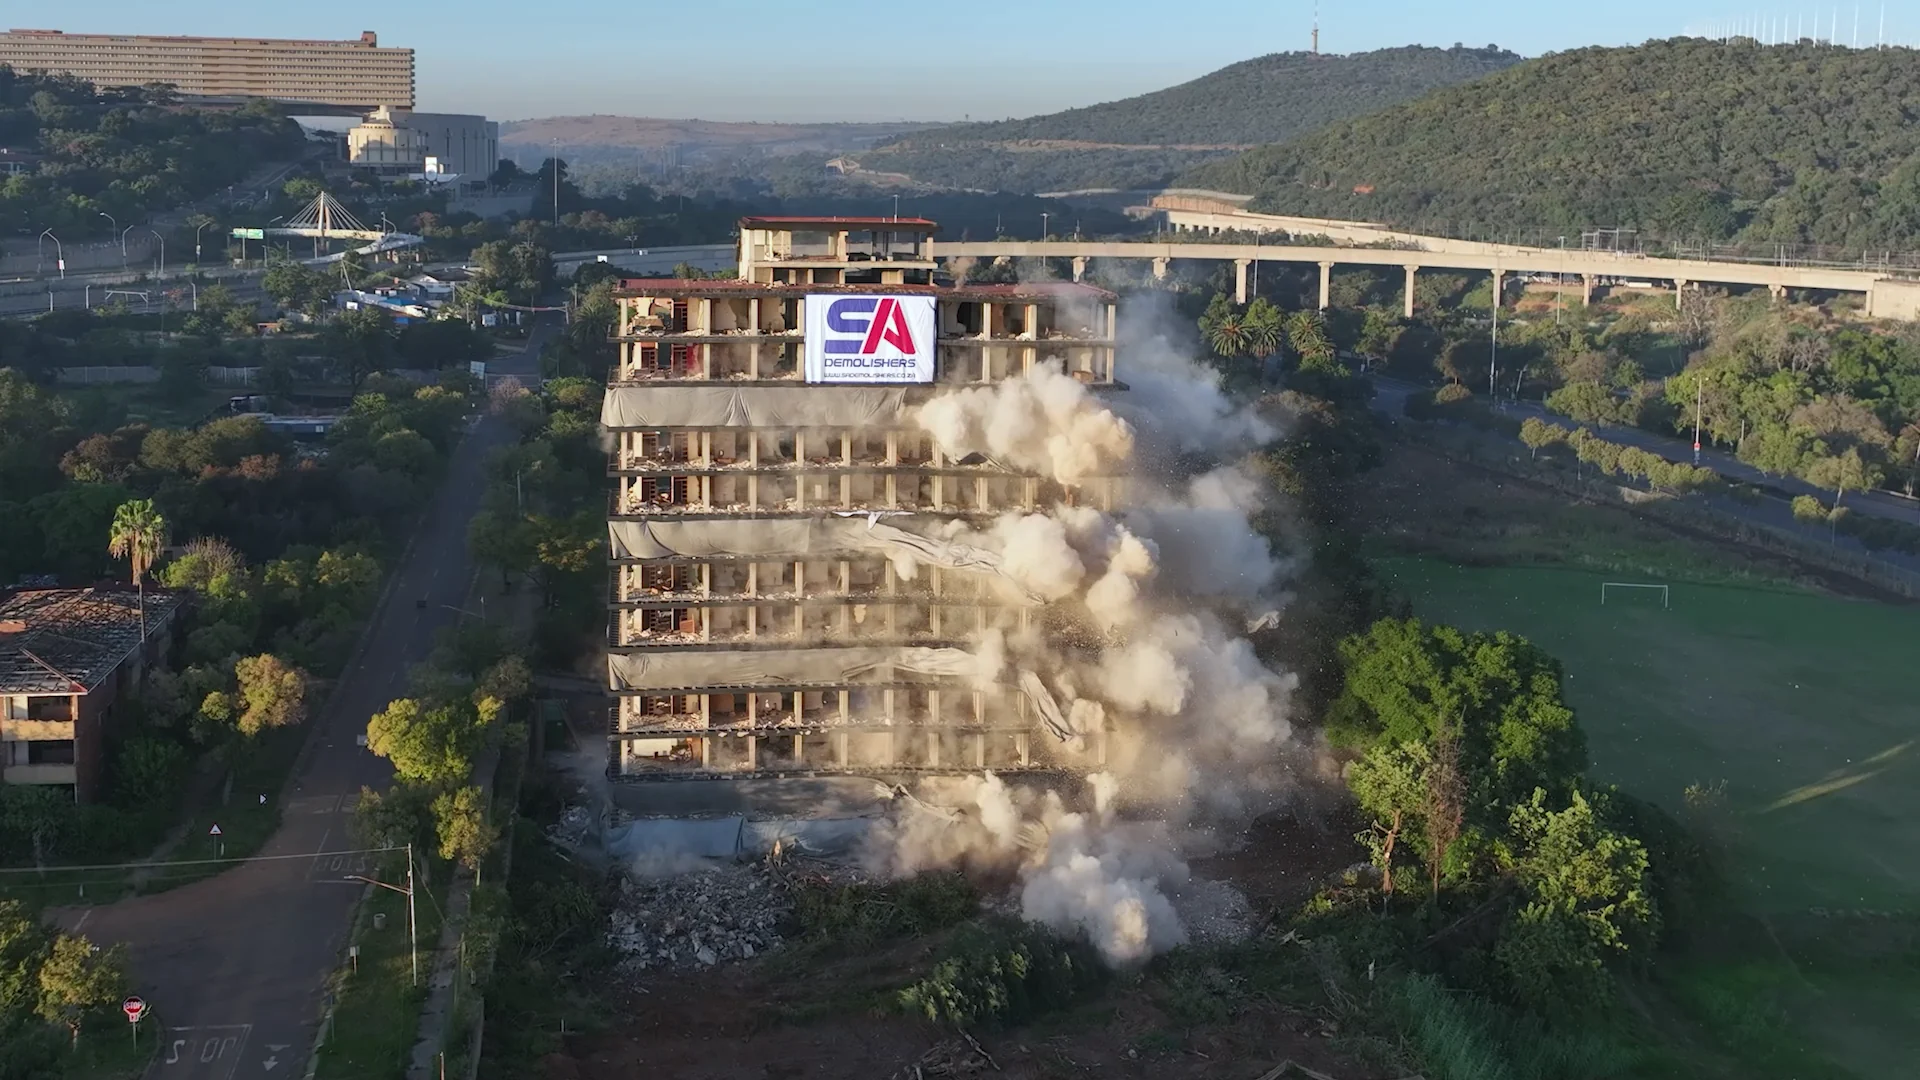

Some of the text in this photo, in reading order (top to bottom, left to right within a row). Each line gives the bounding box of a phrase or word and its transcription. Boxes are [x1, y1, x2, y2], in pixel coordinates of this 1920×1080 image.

[824, 298, 916, 355] SA
[824, 358, 916, 368] DEMOLISHERS
[125, 1001, 142, 1010] STOP
